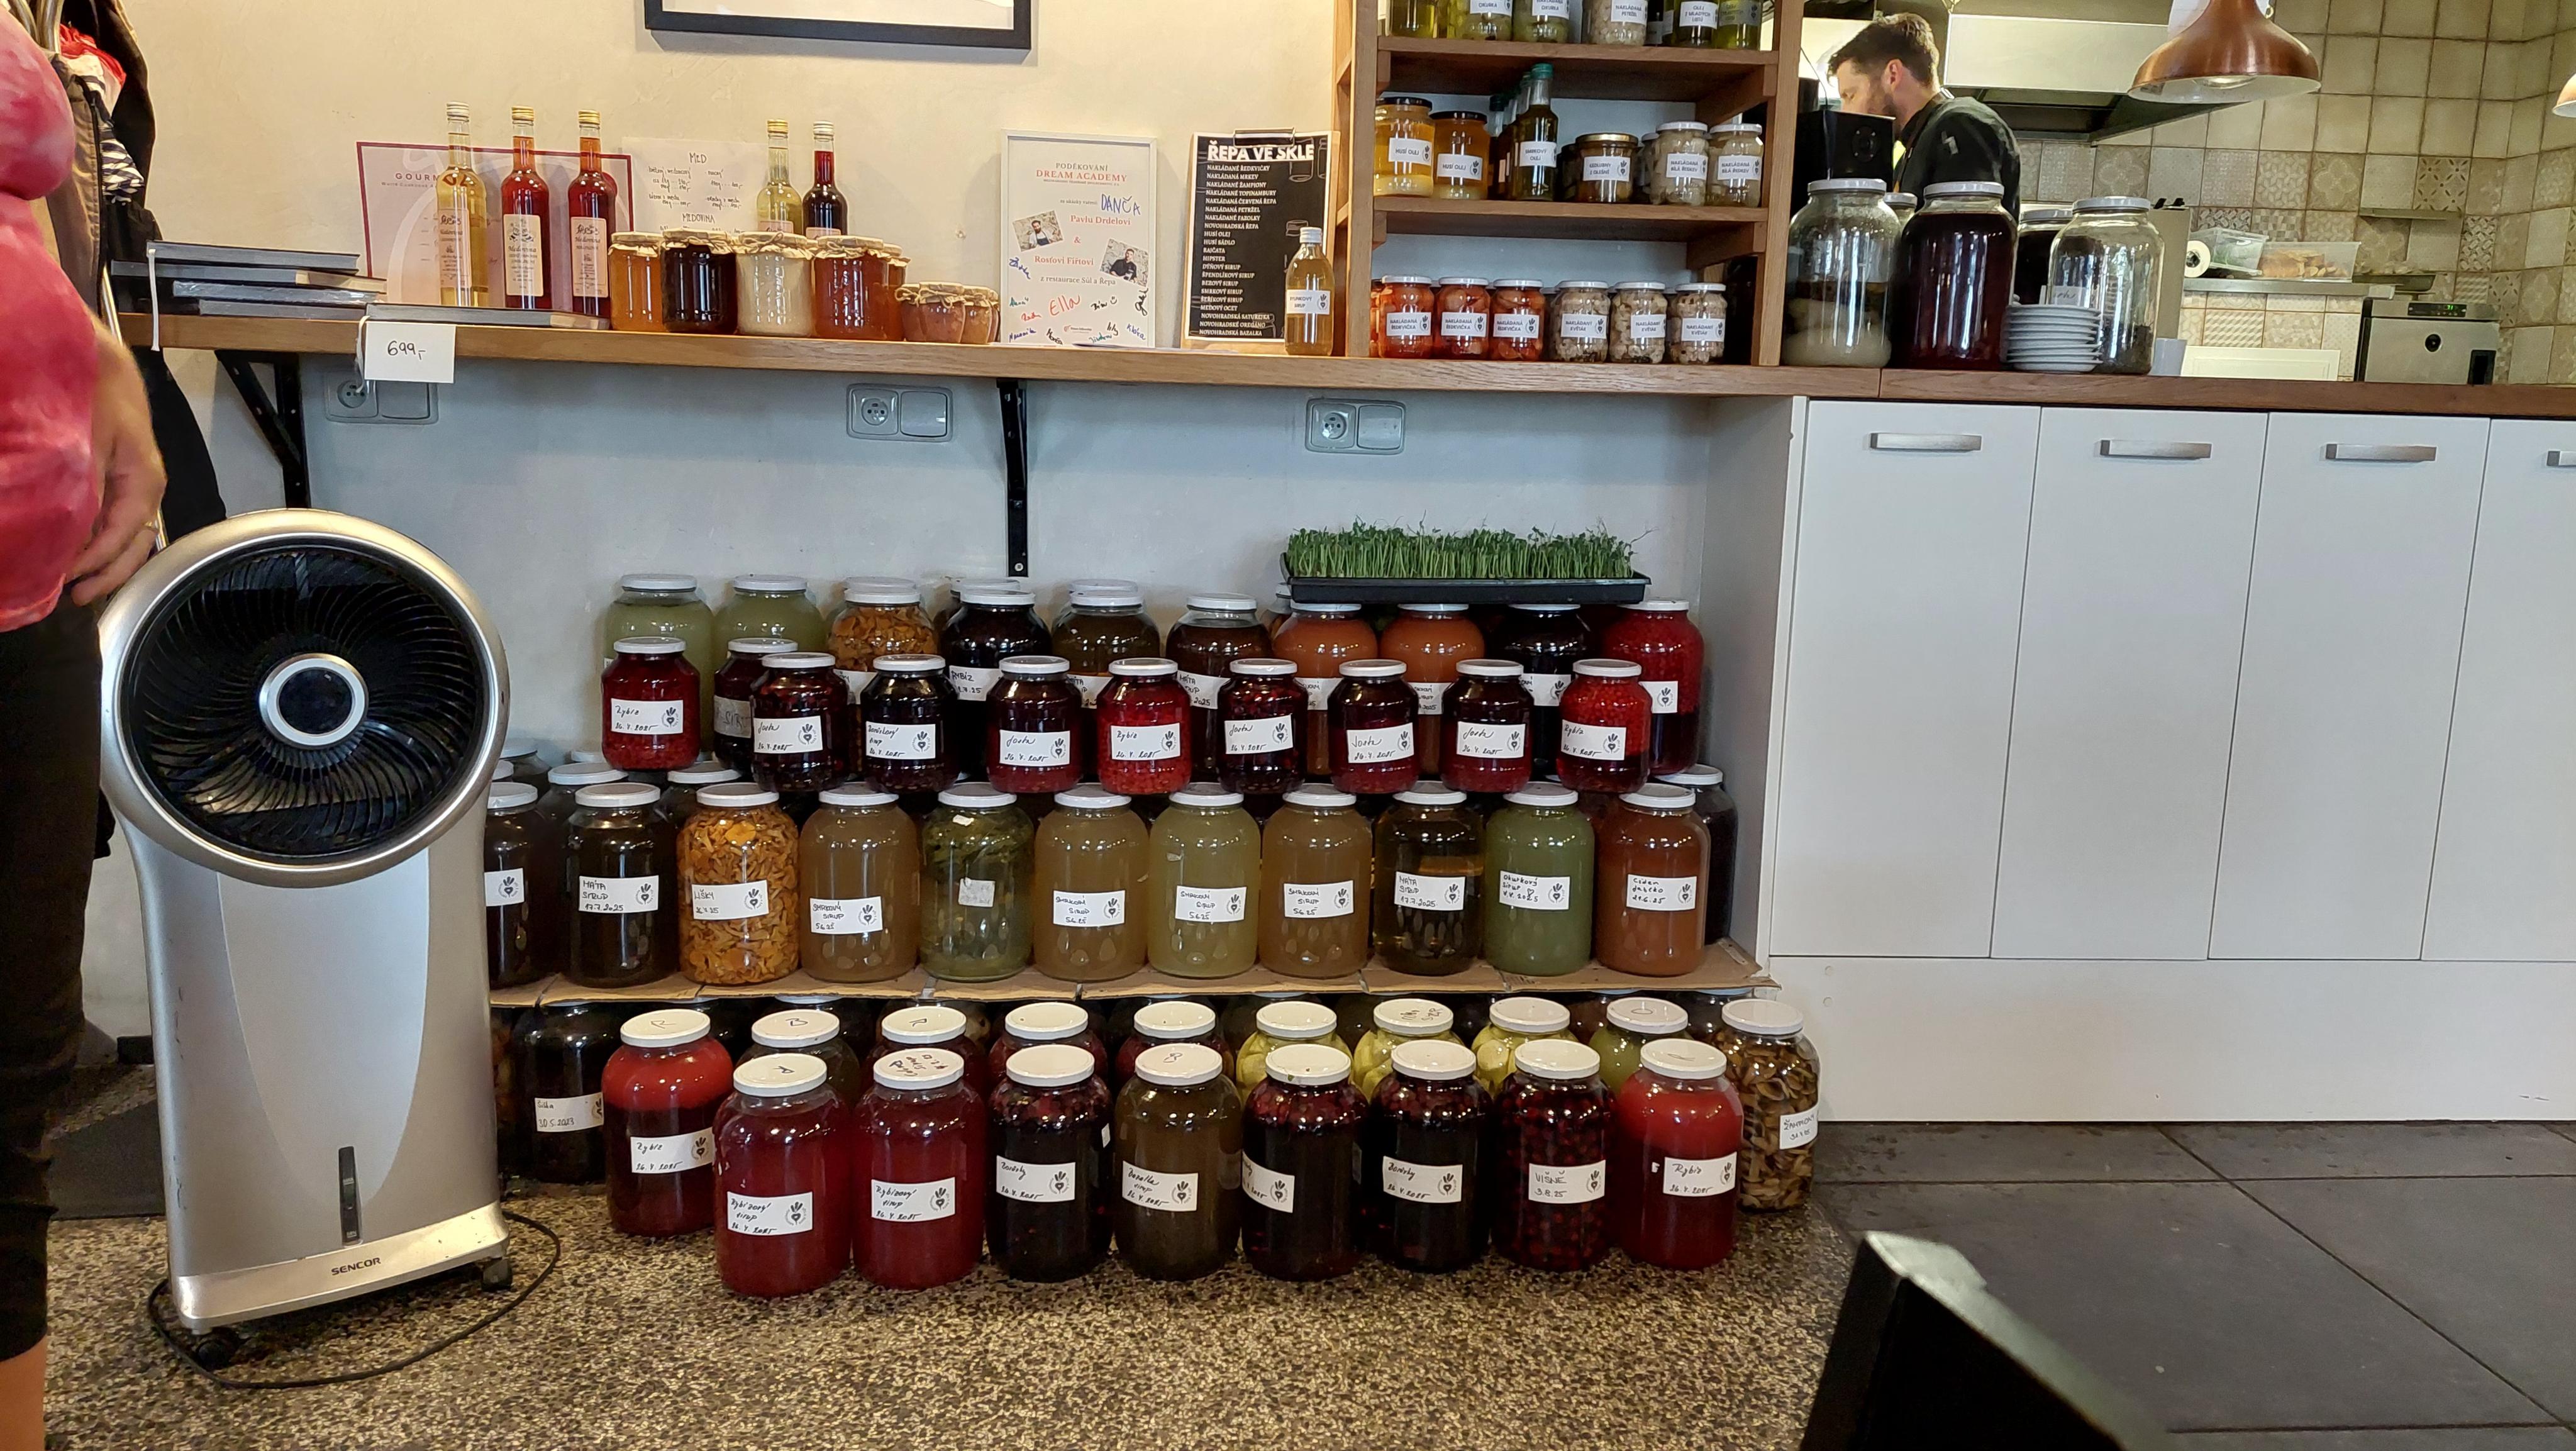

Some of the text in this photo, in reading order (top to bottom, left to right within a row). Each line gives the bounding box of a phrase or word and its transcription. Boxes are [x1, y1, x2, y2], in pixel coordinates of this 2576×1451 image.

[1208, 140, 1314, 161] ŘEPA VE SKLE
[689, 152, 707, 164] MED
[1056, 162, 1108, 172] PODĚKOVÁNÍ
[1036, 169, 1127, 182] DREAM ACADEMY
[1101, 193, 1141, 216] DANČA
[682, 213, 715, 223] MEDOVINA
[1070, 215, 1131, 225] Pavlu Drdelovi
[1074, 236, 1081, 245] &
[1035, 255, 1065, 264] Rosťovi
[1099, 277, 1116, 286] Řepa
[1049, 294, 1081, 316] Ella
[1535, 1170, 1567, 1184] VIŠNĚ
[331, 1257, 381, 1276] SENCOR
